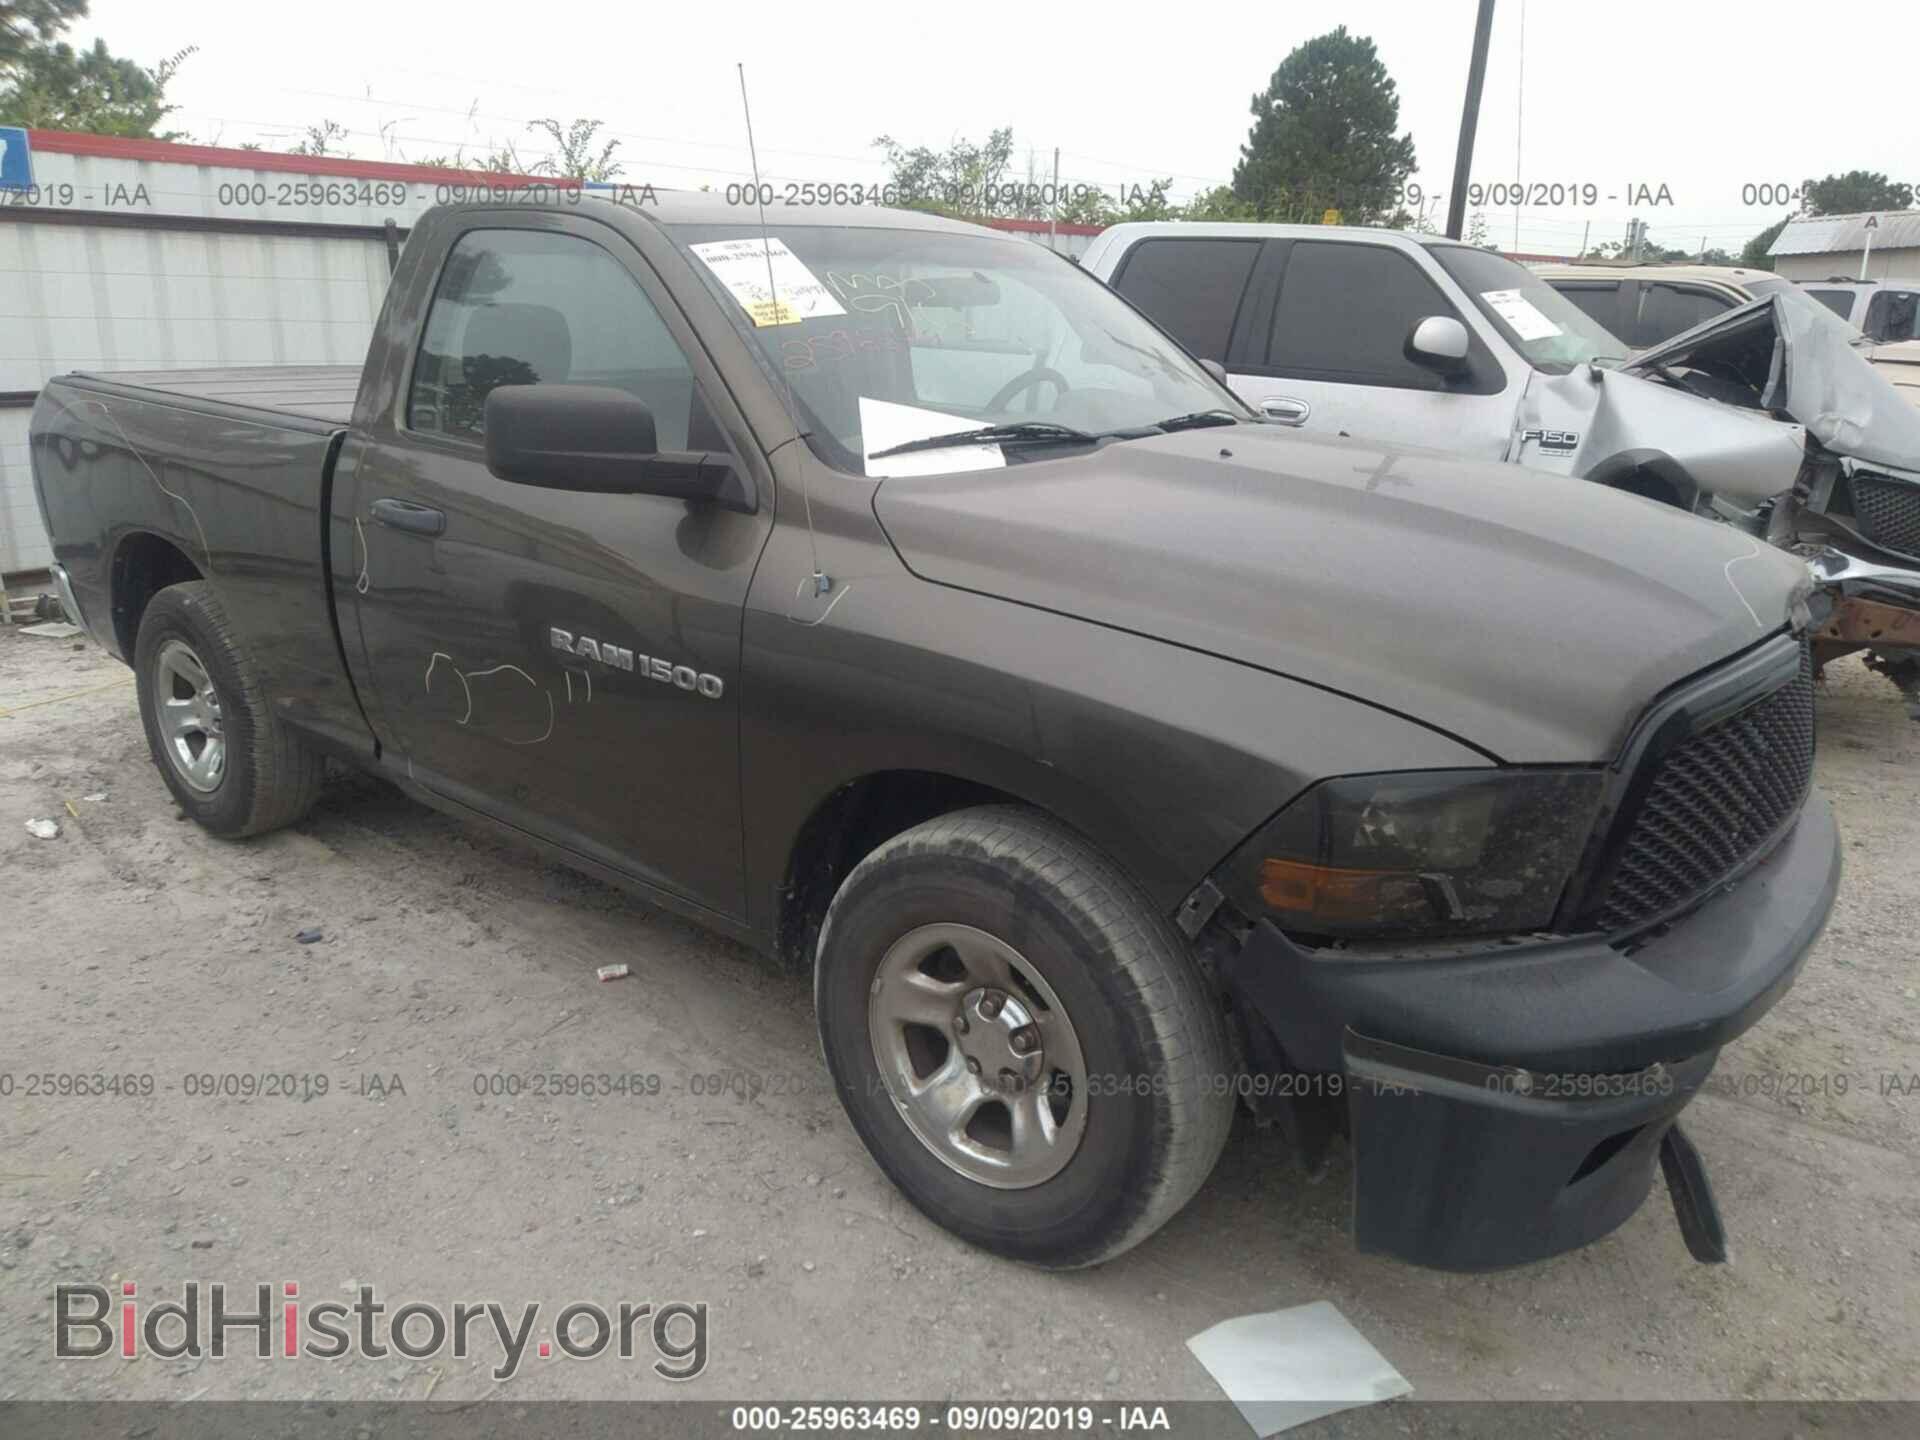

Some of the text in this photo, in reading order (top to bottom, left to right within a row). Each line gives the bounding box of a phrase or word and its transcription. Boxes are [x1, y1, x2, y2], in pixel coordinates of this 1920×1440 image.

[1863, 215, 1879, 229] A
[550, 626, 635, 672] RAM
[638, 653, 724, 699] 1500
